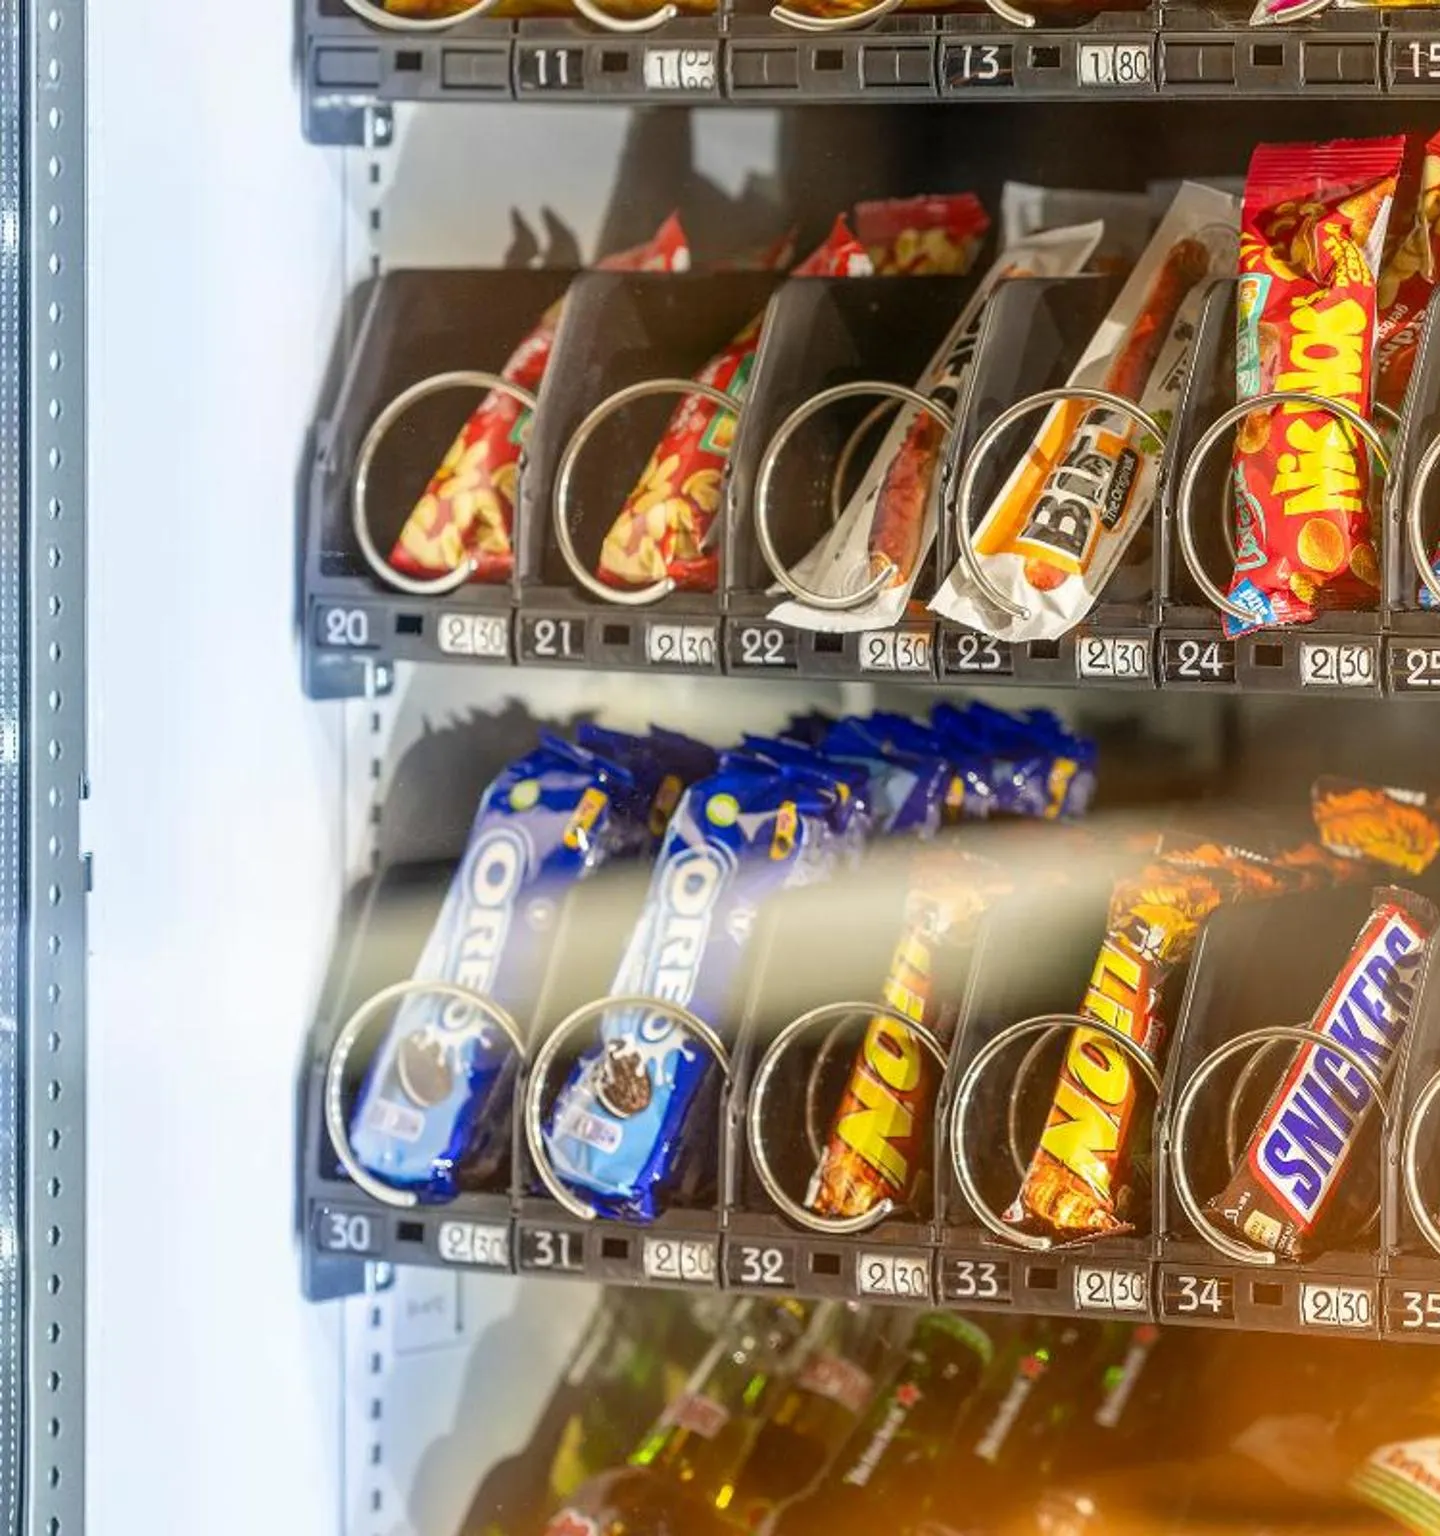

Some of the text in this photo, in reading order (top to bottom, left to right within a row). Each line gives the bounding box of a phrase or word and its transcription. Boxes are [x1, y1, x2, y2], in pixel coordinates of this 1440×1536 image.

[536, 49, 570, 84] 11
[961, 45, 999, 80] 13
[1090, 51, 1148, 83] 1.80
[326, 609, 369, 645] 20
[534, 620, 571, 655] 21
[741, 628, 786, 664] 22
[958, 633, 1002, 670] 23
[1178, 641, 1225, 677] 24
[1263, 925, 1423, 1212] SNICKERS
[329, 1213, 371, 1251] 30
[534, 1231, 571, 1267] 31
[740, 1247, 786, 1284] 32
[956, 1260, 999, 1297] 33
[1177, 1275, 1224, 1314] 34
